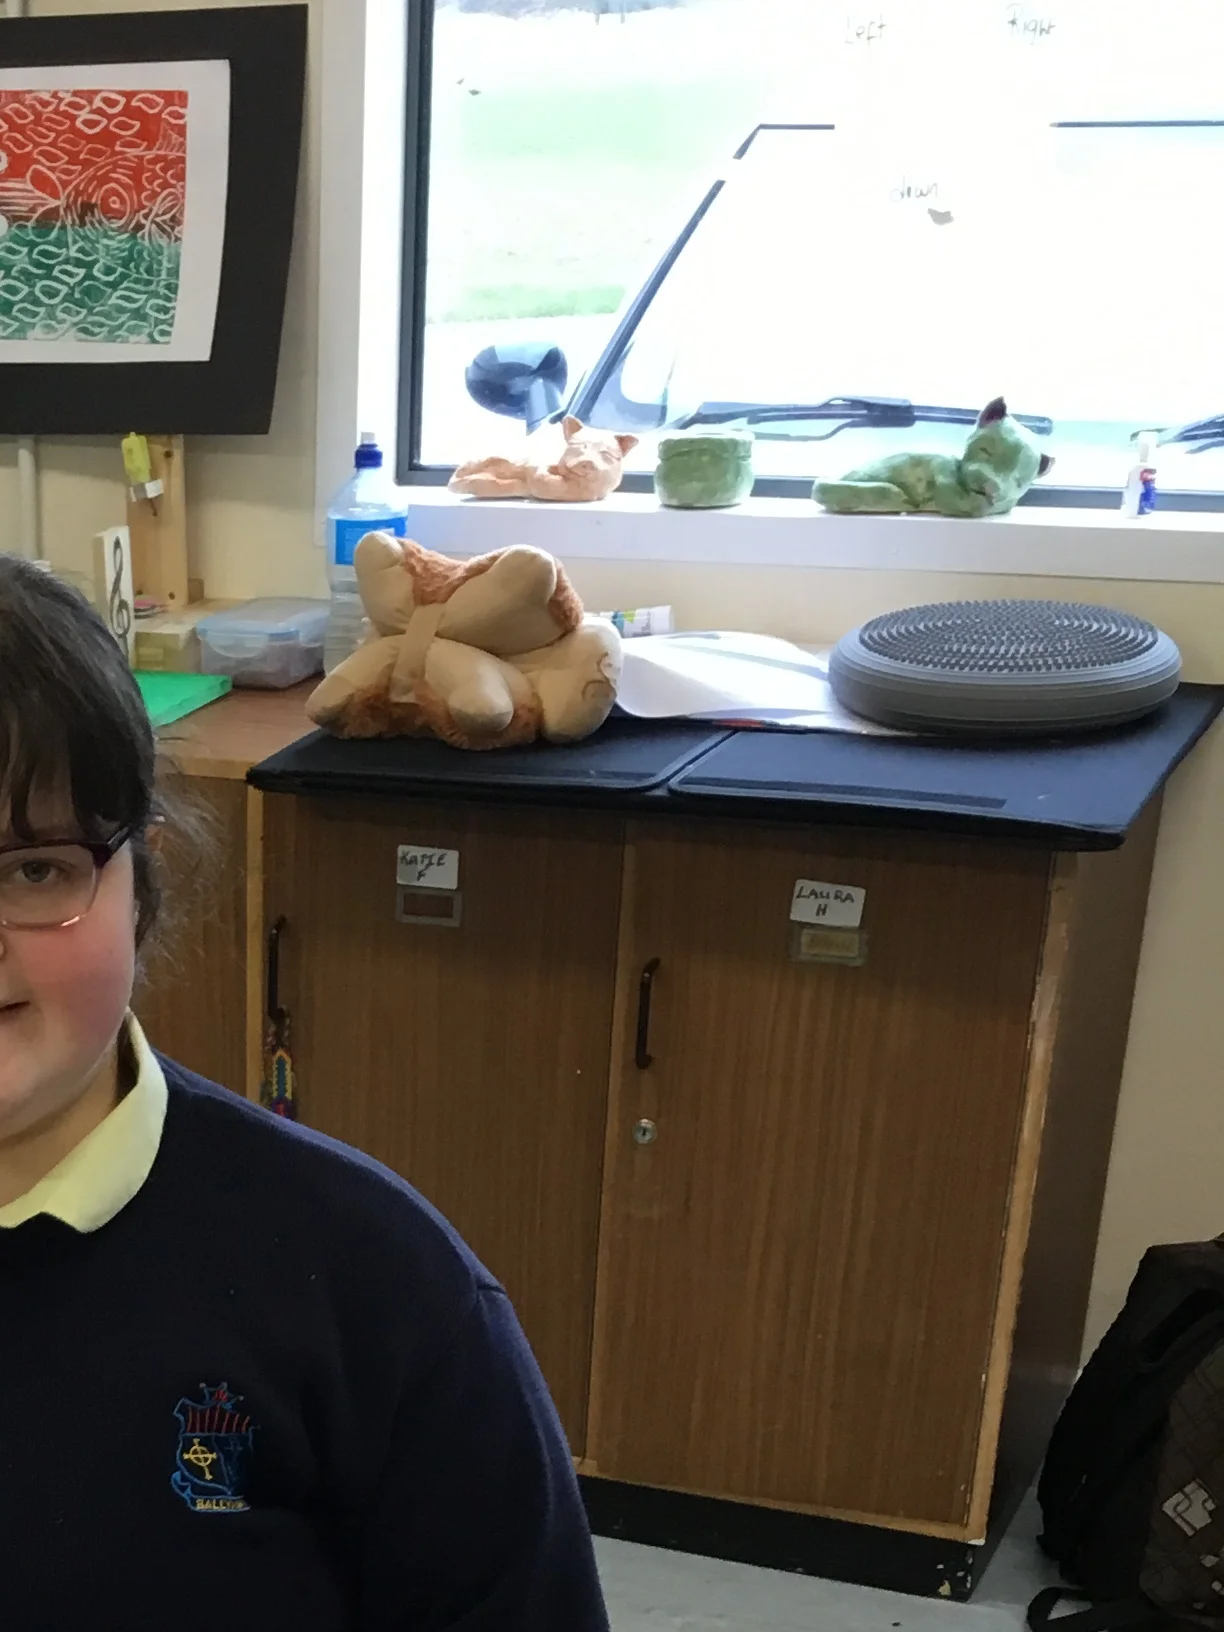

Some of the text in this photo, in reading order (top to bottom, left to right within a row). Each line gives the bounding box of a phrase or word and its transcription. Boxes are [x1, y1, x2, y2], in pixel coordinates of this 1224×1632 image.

[844, 14, 887, 46] Left
[1006, 3, 1057, 45] Right
[796, 886, 855, 903] LAURA
[815, 904, 828, 916] H
